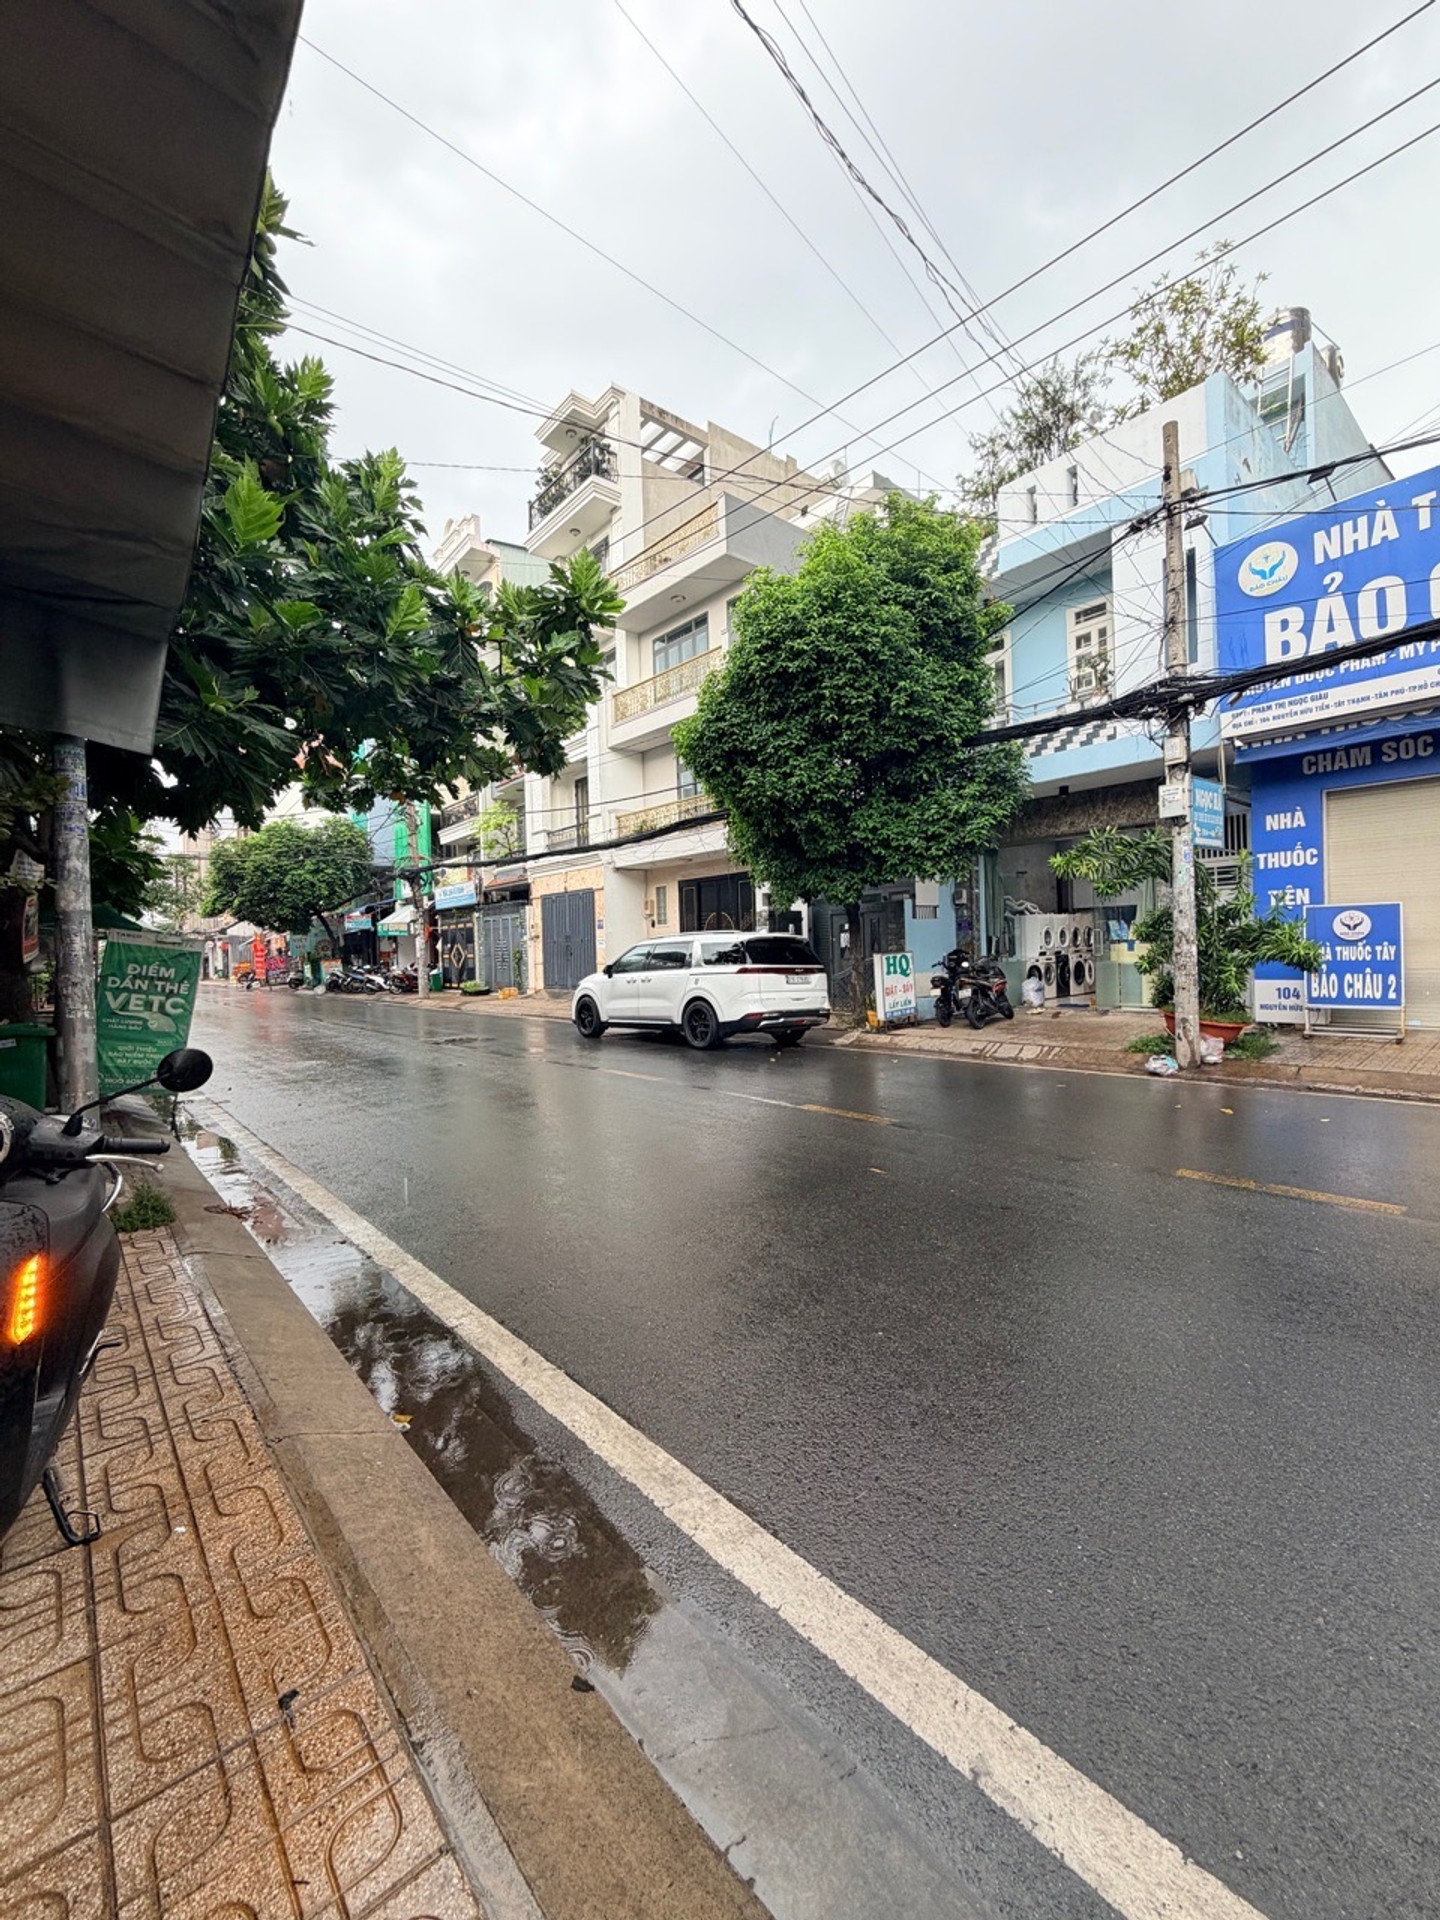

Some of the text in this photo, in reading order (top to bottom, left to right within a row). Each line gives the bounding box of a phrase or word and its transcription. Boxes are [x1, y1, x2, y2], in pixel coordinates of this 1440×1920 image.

[1313, 501, 1400, 565] NHÀ
[1264, 571, 1408, 666] BẢO
[1302, 733, 1434, 775] CHĂM SÓC
[1265, 806, 1306, 831] NHÀ
[1256, 841, 1319, 870] THUỐC
[1335, 940, 1372, 961] THUỐC
[1375, 941, 1397, 961] TÂY
[127, 961, 176, 978] ĐIỂM
[885, 953, 911, 978] HQ
[107, 975, 191, 995] DÁN THẺ
[1275, 987, 1301, 1000] 104
[1311, 963, 1397, 1000] BẢO CHÂU 2
[104, 991, 186, 1015] VETC
